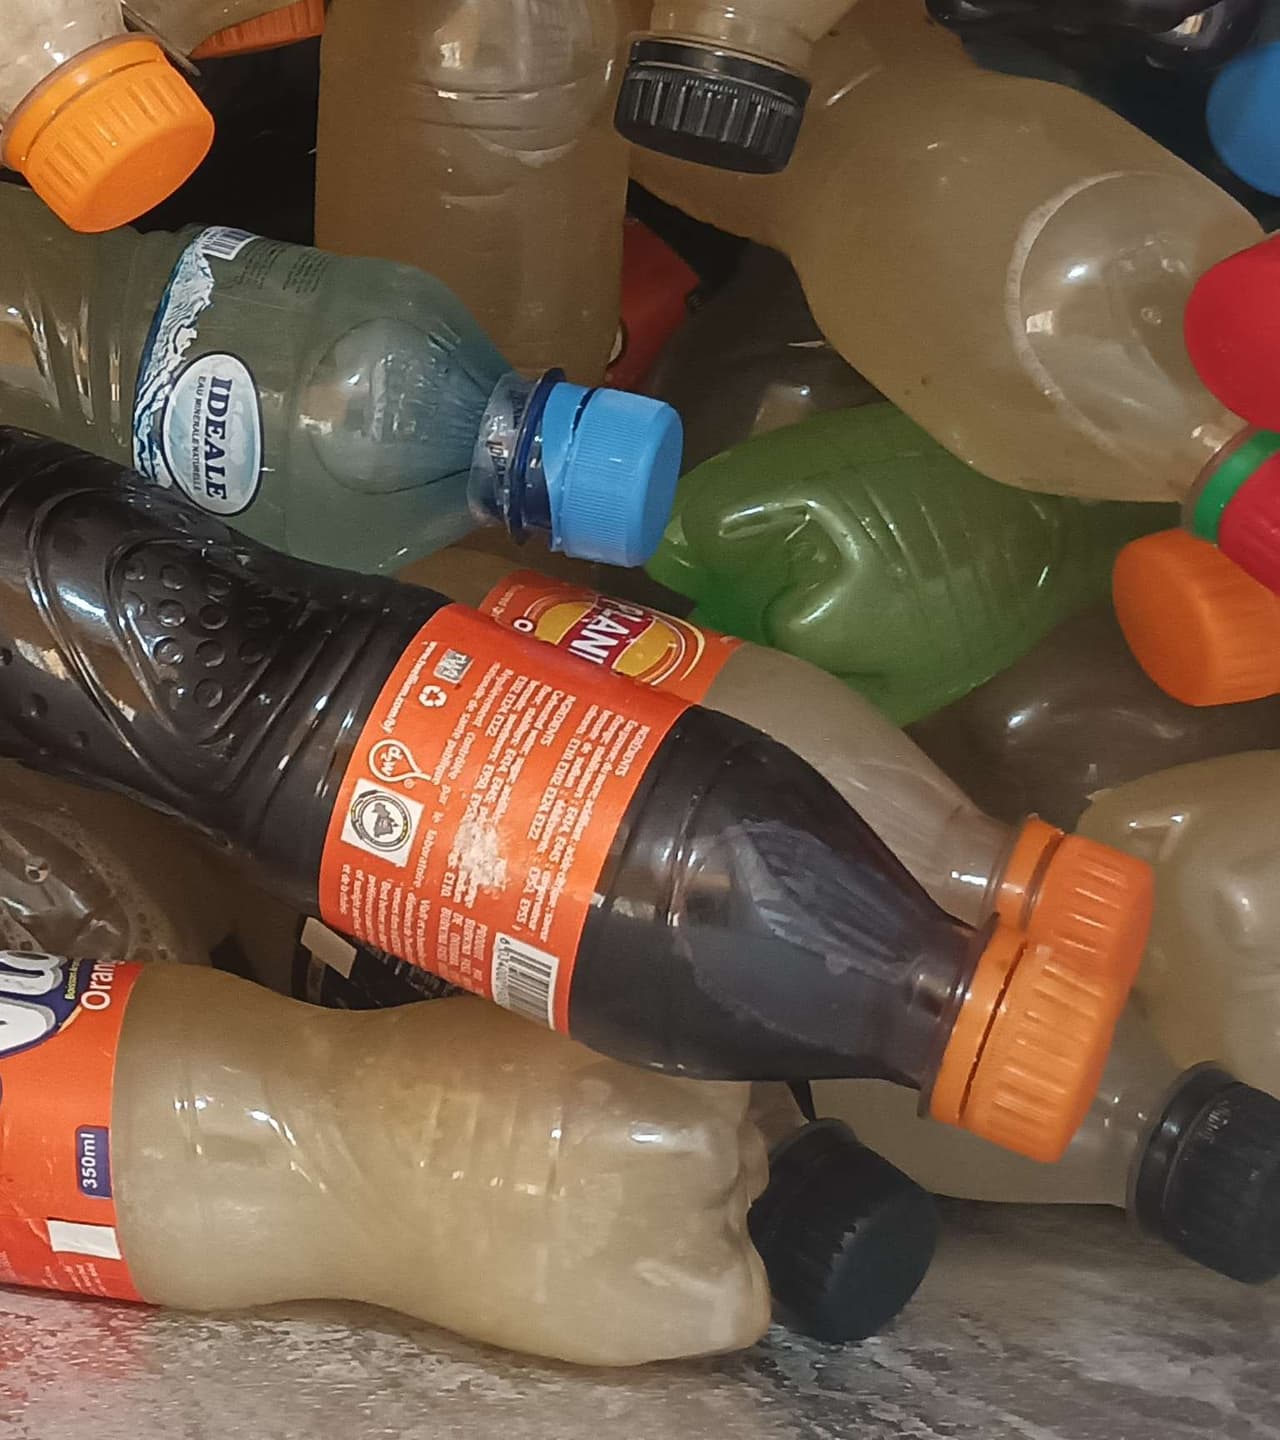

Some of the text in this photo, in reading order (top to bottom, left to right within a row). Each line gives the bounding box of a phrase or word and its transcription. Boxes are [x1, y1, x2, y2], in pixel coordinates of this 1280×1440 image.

[194, 374, 243, 501] IDEALE
[428, 737, 458, 787] publique
[412, 827, 438, 889] laboratoire
[71, 1131, 107, 1189] 350ml
